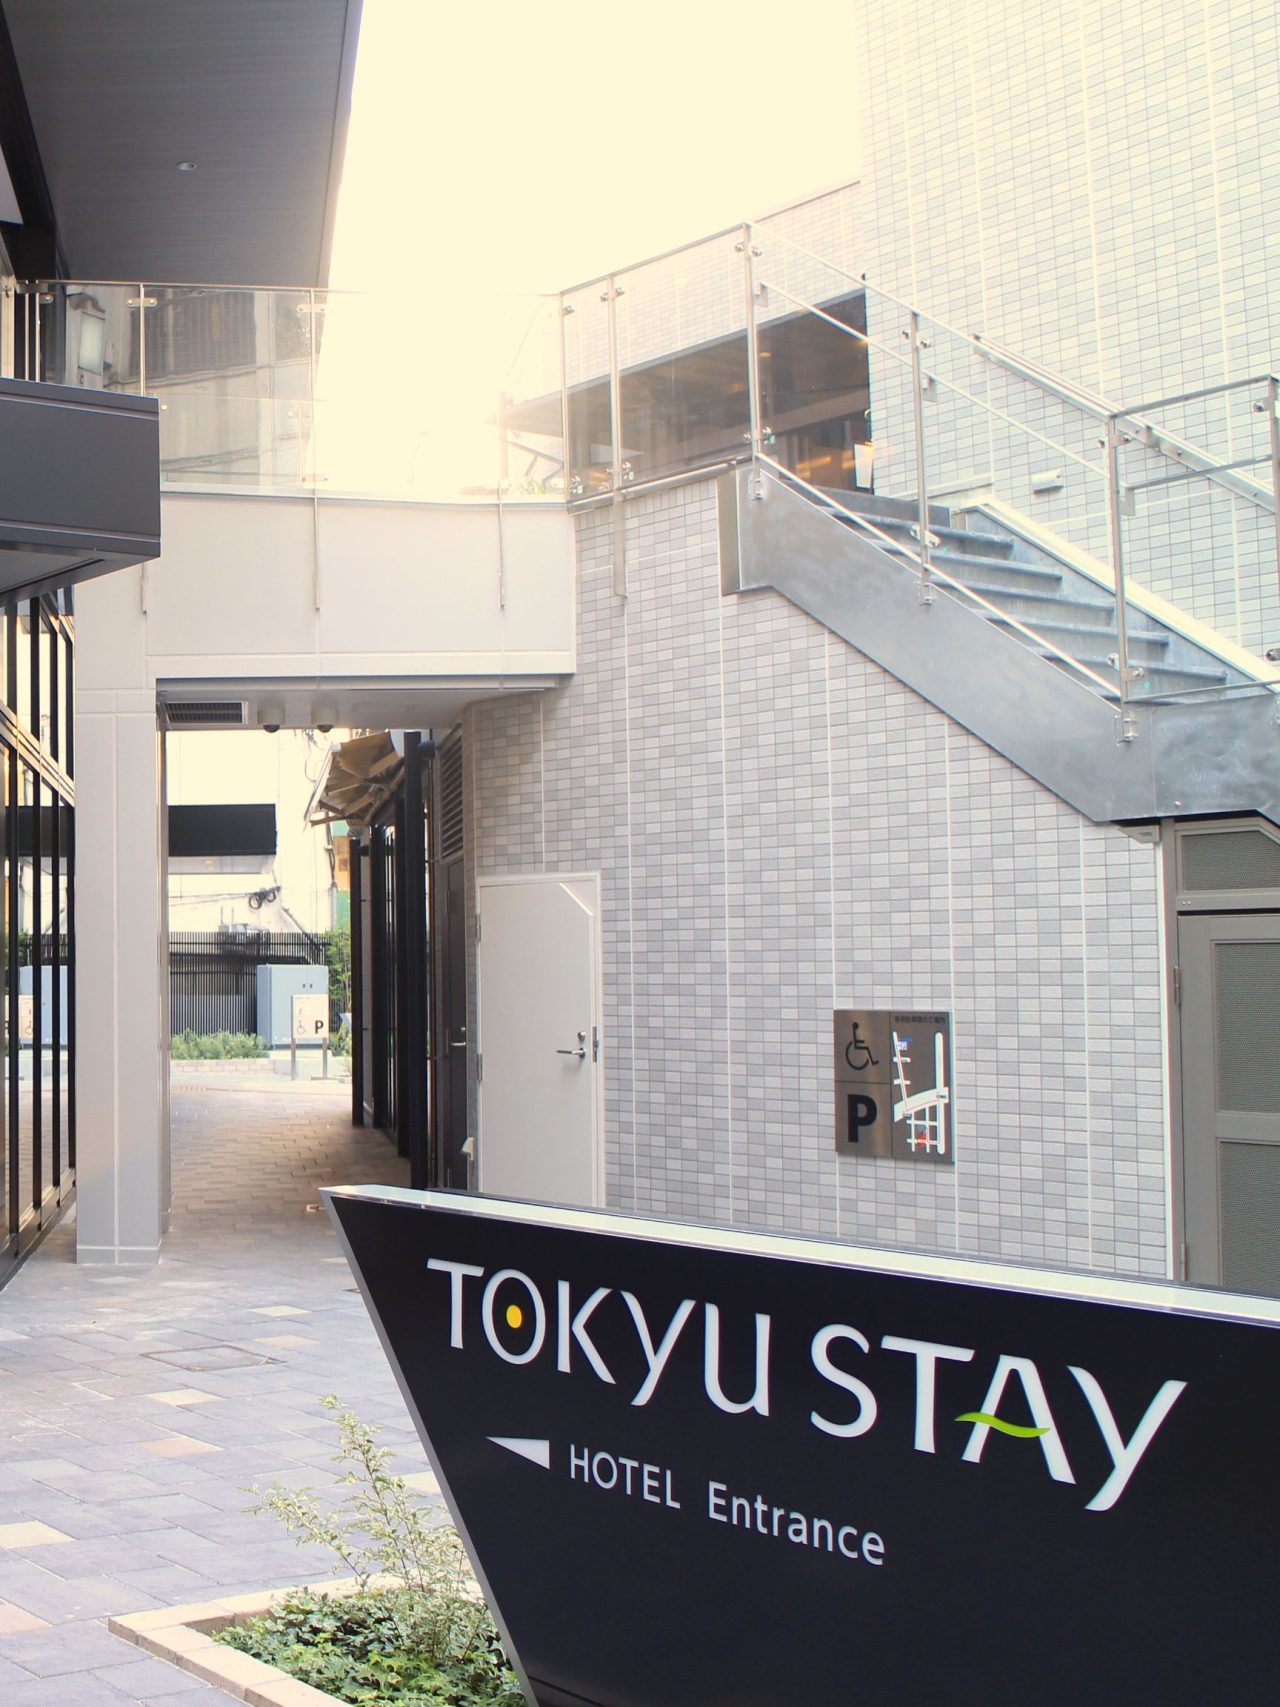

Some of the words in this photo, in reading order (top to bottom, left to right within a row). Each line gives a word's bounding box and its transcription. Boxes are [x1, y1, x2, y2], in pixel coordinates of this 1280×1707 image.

[315, 1020, 324, 1034] P
[847, 1093, 877, 1143] P
[427, 1258, 770, 1418] TOKYU
[810, 1323, 1187, 1512] STAY
[570, 1444, 681, 1510] HOTEL
[708, 1483, 885, 1567] Entrance
